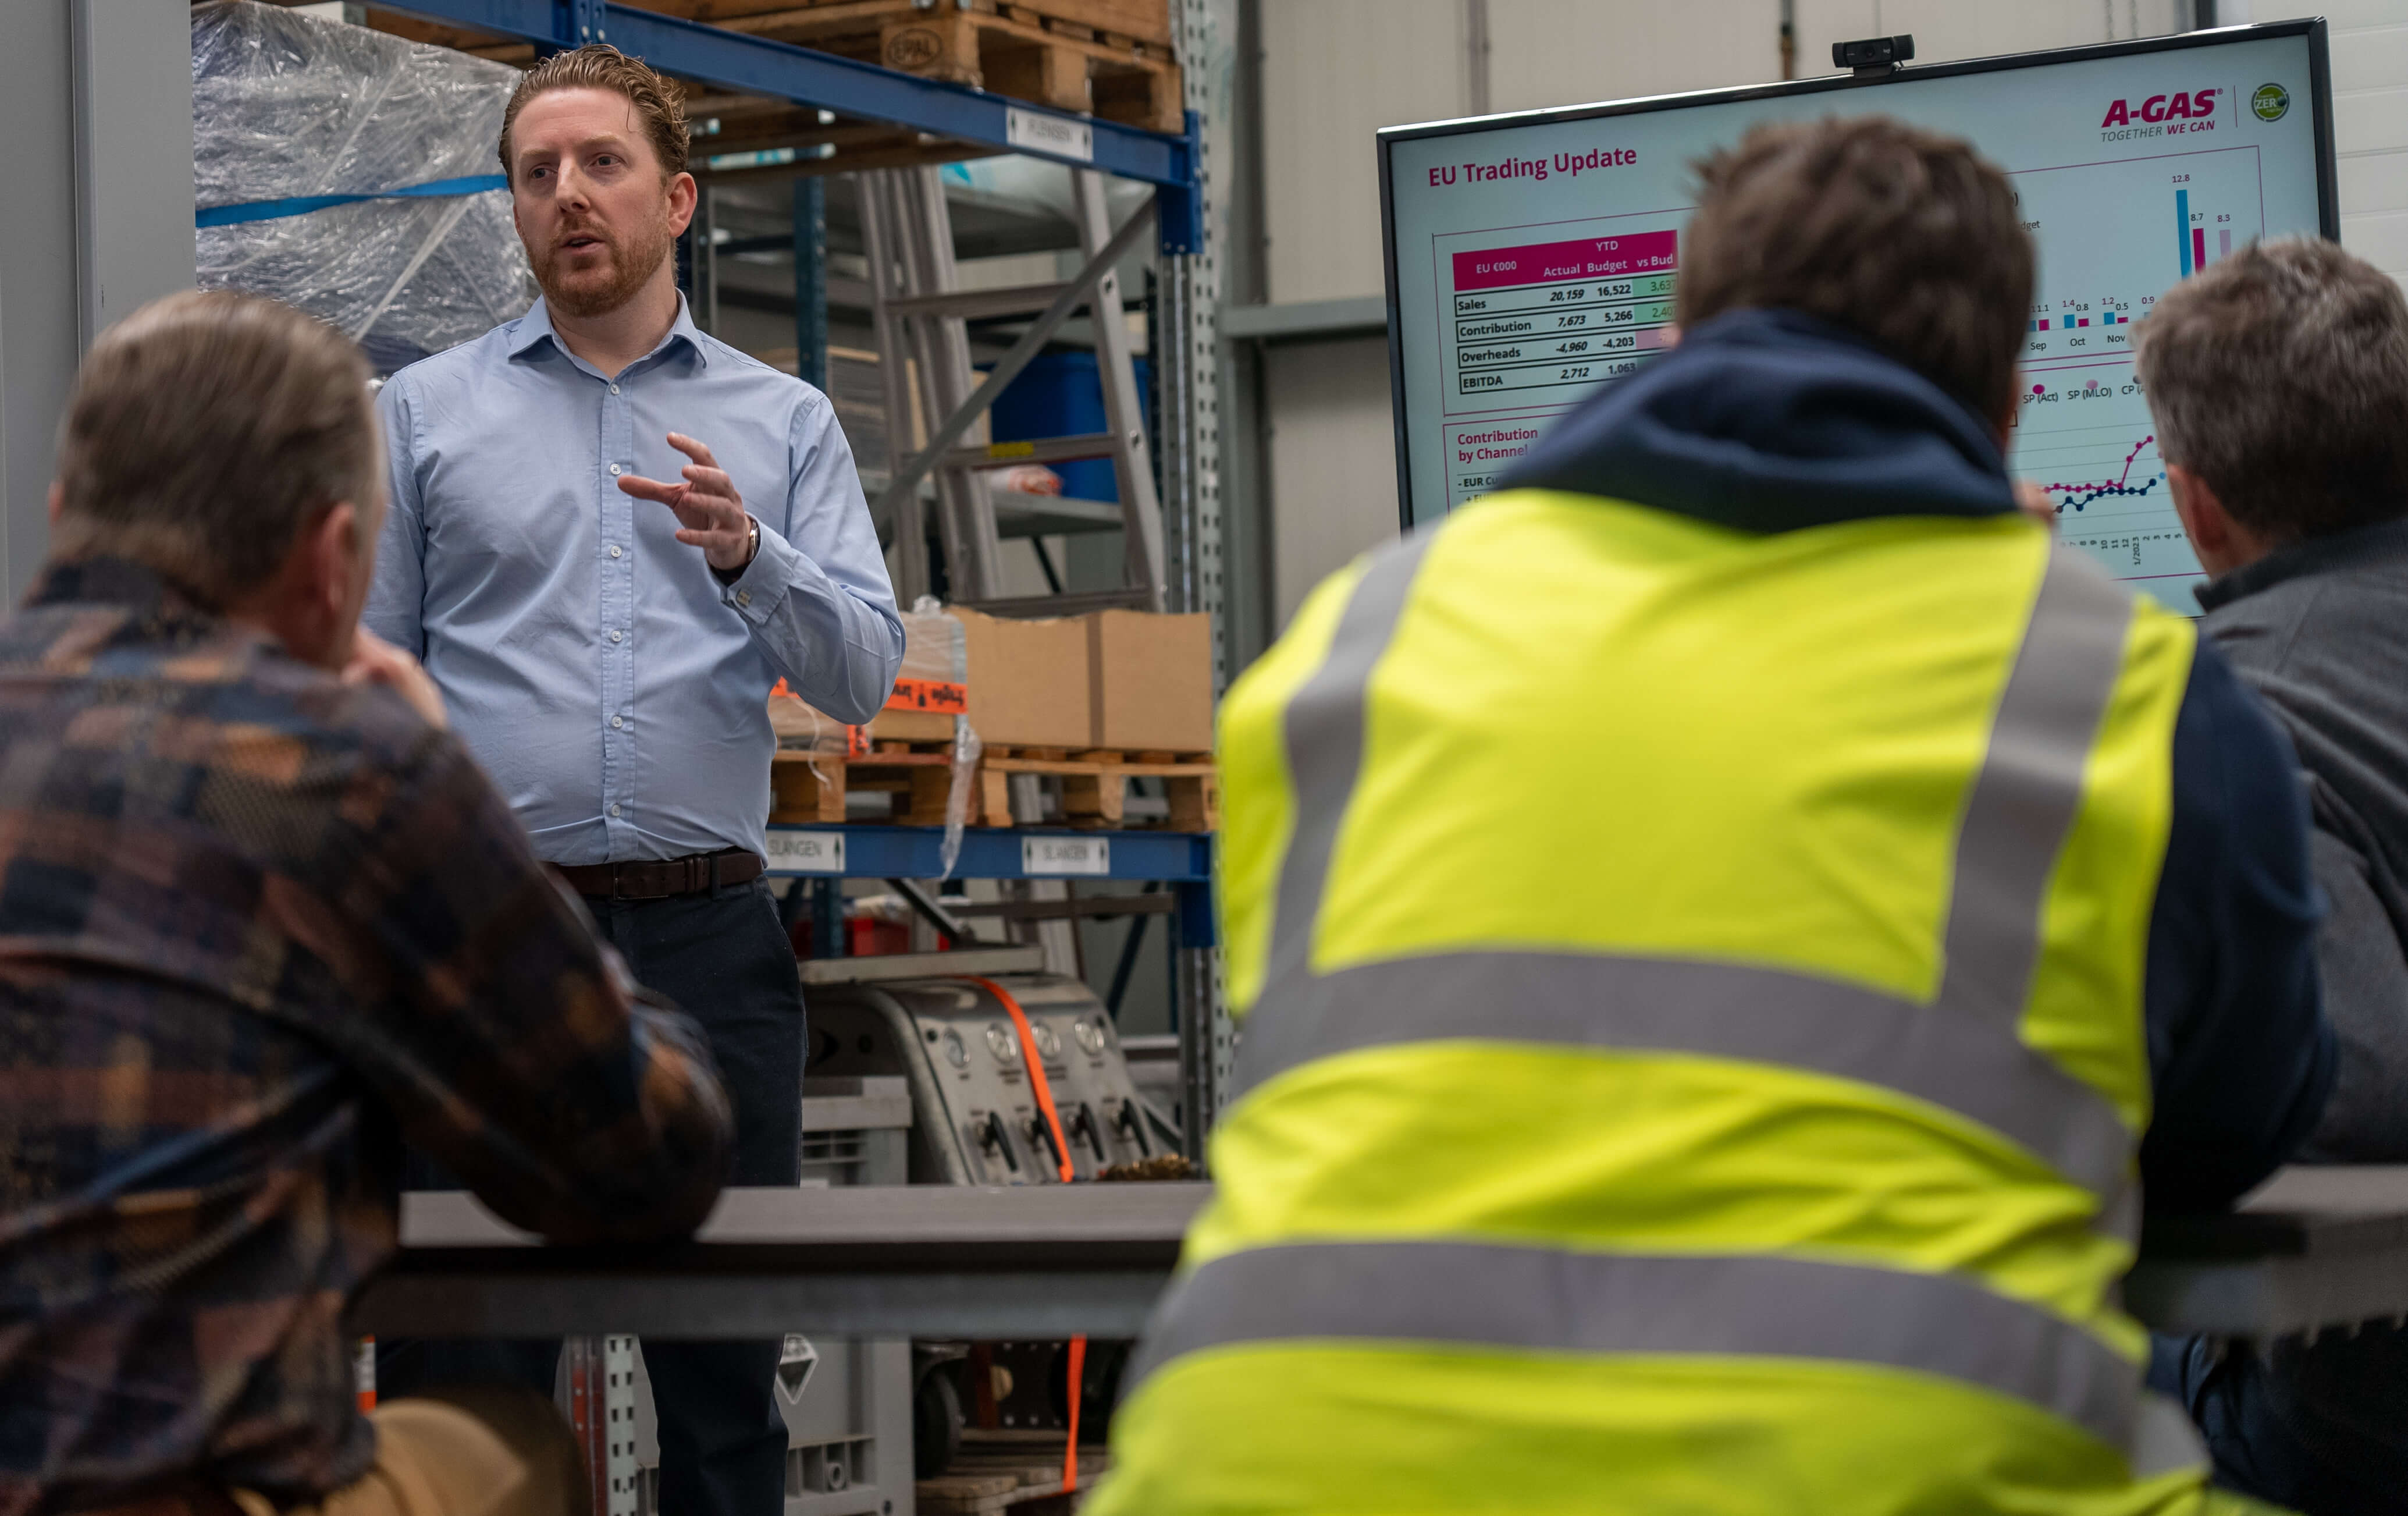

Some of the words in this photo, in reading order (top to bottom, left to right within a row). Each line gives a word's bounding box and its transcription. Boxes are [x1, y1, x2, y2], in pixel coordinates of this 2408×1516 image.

[2101, 126, 2162, 142] TOGETHER
[2167, 123, 2186, 135] WE
[2190, 120, 2215, 133] CAN
[1429, 166, 1456, 187] EU
[1463, 157, 1548, 180] Trading
[1554, 148, 1637, 176] Update
[2172, 174, 2190, 183] 12.8
[2190, 213, 2203, 222] 8.7
[2217, 214, 2231, 222] 8.3
[2020, 221, 2041, 232] dget
[1596, 240, 1619, 251] YTD
[1476, 263, 1490, 274] EU
[1493, 261, 1517, 272] €000
[1543, 263, 1581, 278] Actual
[1587, 260, 1628, 274] Budget
[1637, 258, 1648, 267] vs
[1651, 254, 1673, 267] Bud
[1458, 299, 1486, 311] Sales
[1550, 289, 1584, 303] 20,159
[1598, 285, 1631, 297] 16,522
[2102, 297, 2115, 306] 1.2
[2142, 296, 2155, 304] 0.9
[2062, 299, 2075, 308] 1.4
[2076, 303, 2089, 311] 0.8
[2115, 303, 2129, 311] 0.5
[1460, 321, 1532, 336] Contribution
[1557, 315, 1586, 327] 7,673
[1604, 311, 1633, 323] 5,266
[2070, 338, 2086, 347] Oct
[2107, 335, 2126, 343] Nov
[1461, 348, 1521, 363] Overheads
[1556, 341, 1588, 353] -4,960
[1603, 337, 1634, 349] -4,203
[2030, 342, 2047, 352] Sep
[1463, 376, 1503, 389] EBITDA
[1560, 367, 1590, 379] 2,712
[2068, 390, 2080, 400] SP
[2083, 387, 2112, 400] (MLO)
[2121, 385, 2135, 395] CP
[2023, 395, 2035, 404] SP
[2037, 392, 2059, 404] (Act)
[1457, 428, 1538, 445] Contribution
[1459, 450, 1474, 464] by
[1477, 443, 1528, 460] Channel
[1464, 477, 1484, 487] EUR
[2101, 539, 2108, 549] 10
[2111, 539, 2118, 548] 11
[2122, 538, 2129, 548] 12
[2132, 537, 2141, 565] 1/2023
